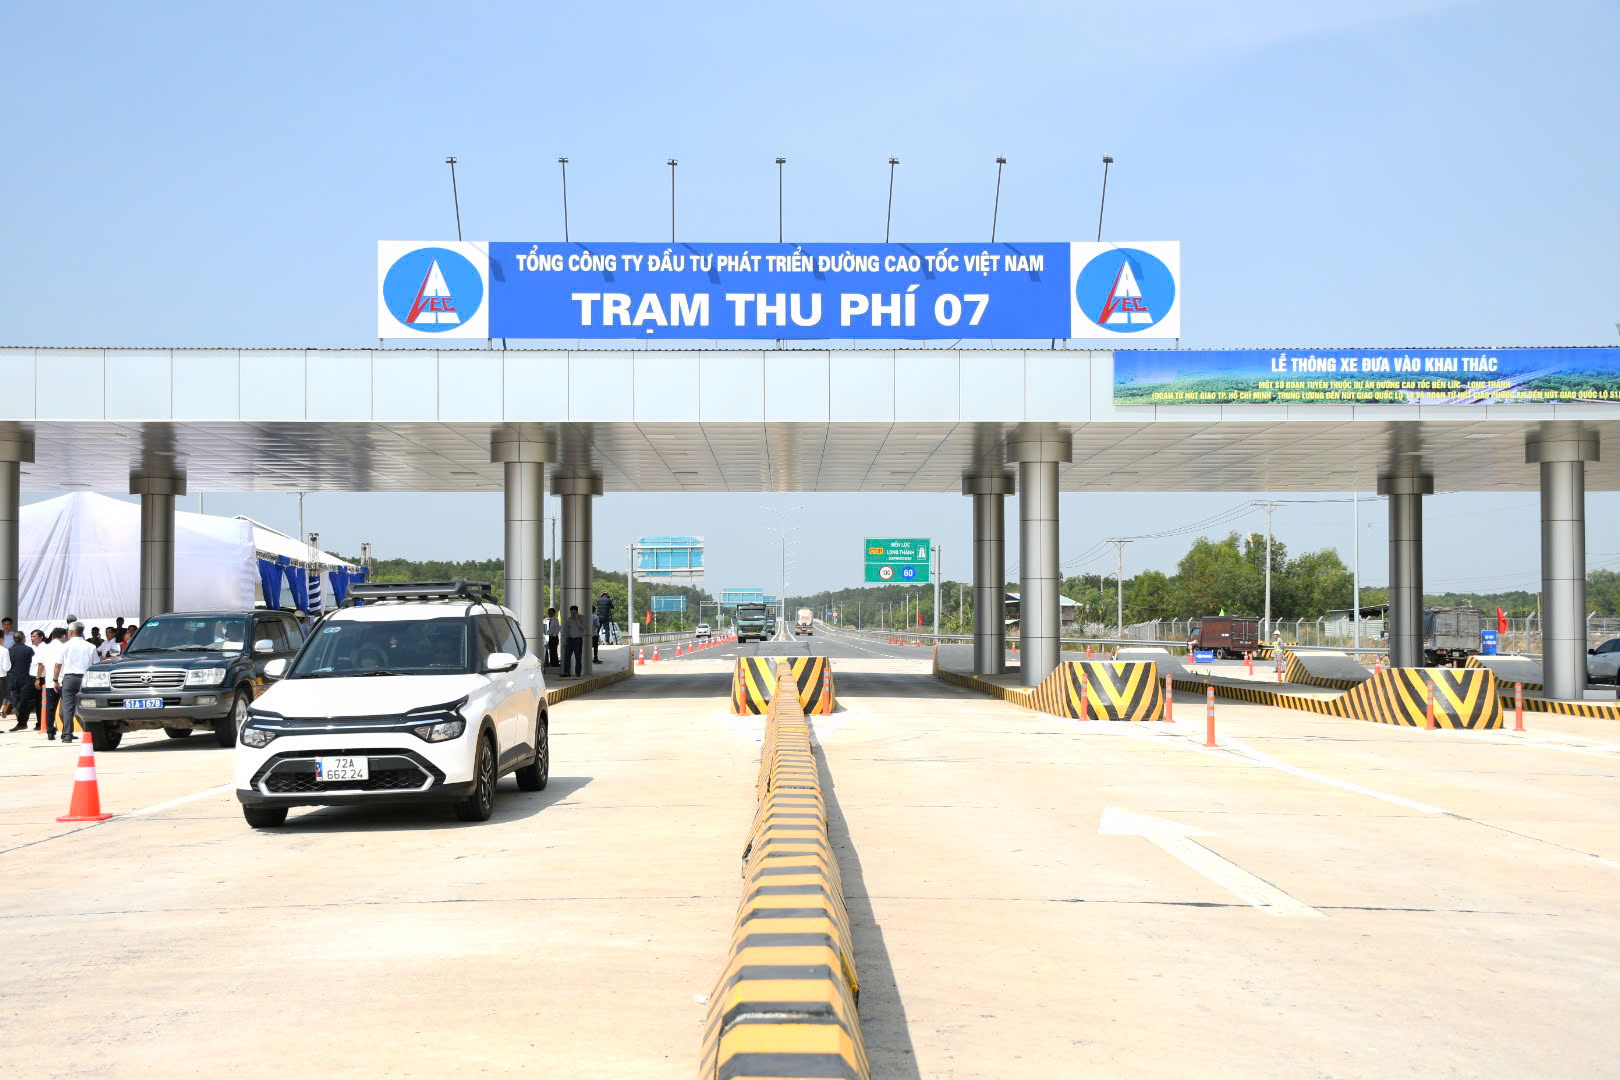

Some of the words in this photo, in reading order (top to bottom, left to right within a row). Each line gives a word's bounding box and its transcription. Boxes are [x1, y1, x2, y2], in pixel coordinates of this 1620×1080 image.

[516, 244, 564, 272] TỔNG
[569, 250, 617, 272] CÔNG
[622, 254, 644, 272] TY
[648, 248, 685, 272] ĐẦU
[690, 252, 714, 272] TƯ
[717, 250, 762, 272] PHÁT
[766, 246, 814, 272] TRIỂN
[818, 250, 880, 272] ĐƯỜNG
[886, 254, 921, 272] CAO
[925, 247, 961, 272] TỐC
[964, 250, 1000, 277] VIỆT
[1005, 254, 1044, 272] NAM
[571, 292, 710, 334] TRẠM
[725, 292, 822, 327] THU
[840, 283, 920, 327] PHÍ
[934, 293, 990, 327] 07
[1271, 353, 1287, 373] LỄ
[1291, 355, 1337, 373] THÔNG
[1341, 357, 1358, 372] XE
[1362, 356, 1390, 372] ĐƯA
[1394, 355, 1421, 372] VÀO
[1425, 357, 1458, 372] KHAI
[1462, 354, 1498, 372] THÁC
[1274, 379, 1285, 389] SỐ
[1401, 381, 1416, 389] CAO
[1417, 379, 1430, 389] TỐC
[1431, 379, 1447, 389] BẾN
[1467, 381, 1486, 389] LONG
[1200, 391, 1217, 400] GIAO
[1217, 391, 1227, 400] TP.
[1228, 390, 1239, 400] HỒ
[1253, 391, 1272, 400] MINH
[1278, 391, 1300, 400] TRUNG
[1356, 391, 1373, 400] GIAO
[1374, 390, 1393, 400] QUỐC
[1560, 391, 1577, 399] GIAO
[1578, 389, 1598, 399] QUỐC
[903, 569, 913, 577] 60
[336, 758, 354, 769] 72A
[327, 769, 363, 780] 662.24
